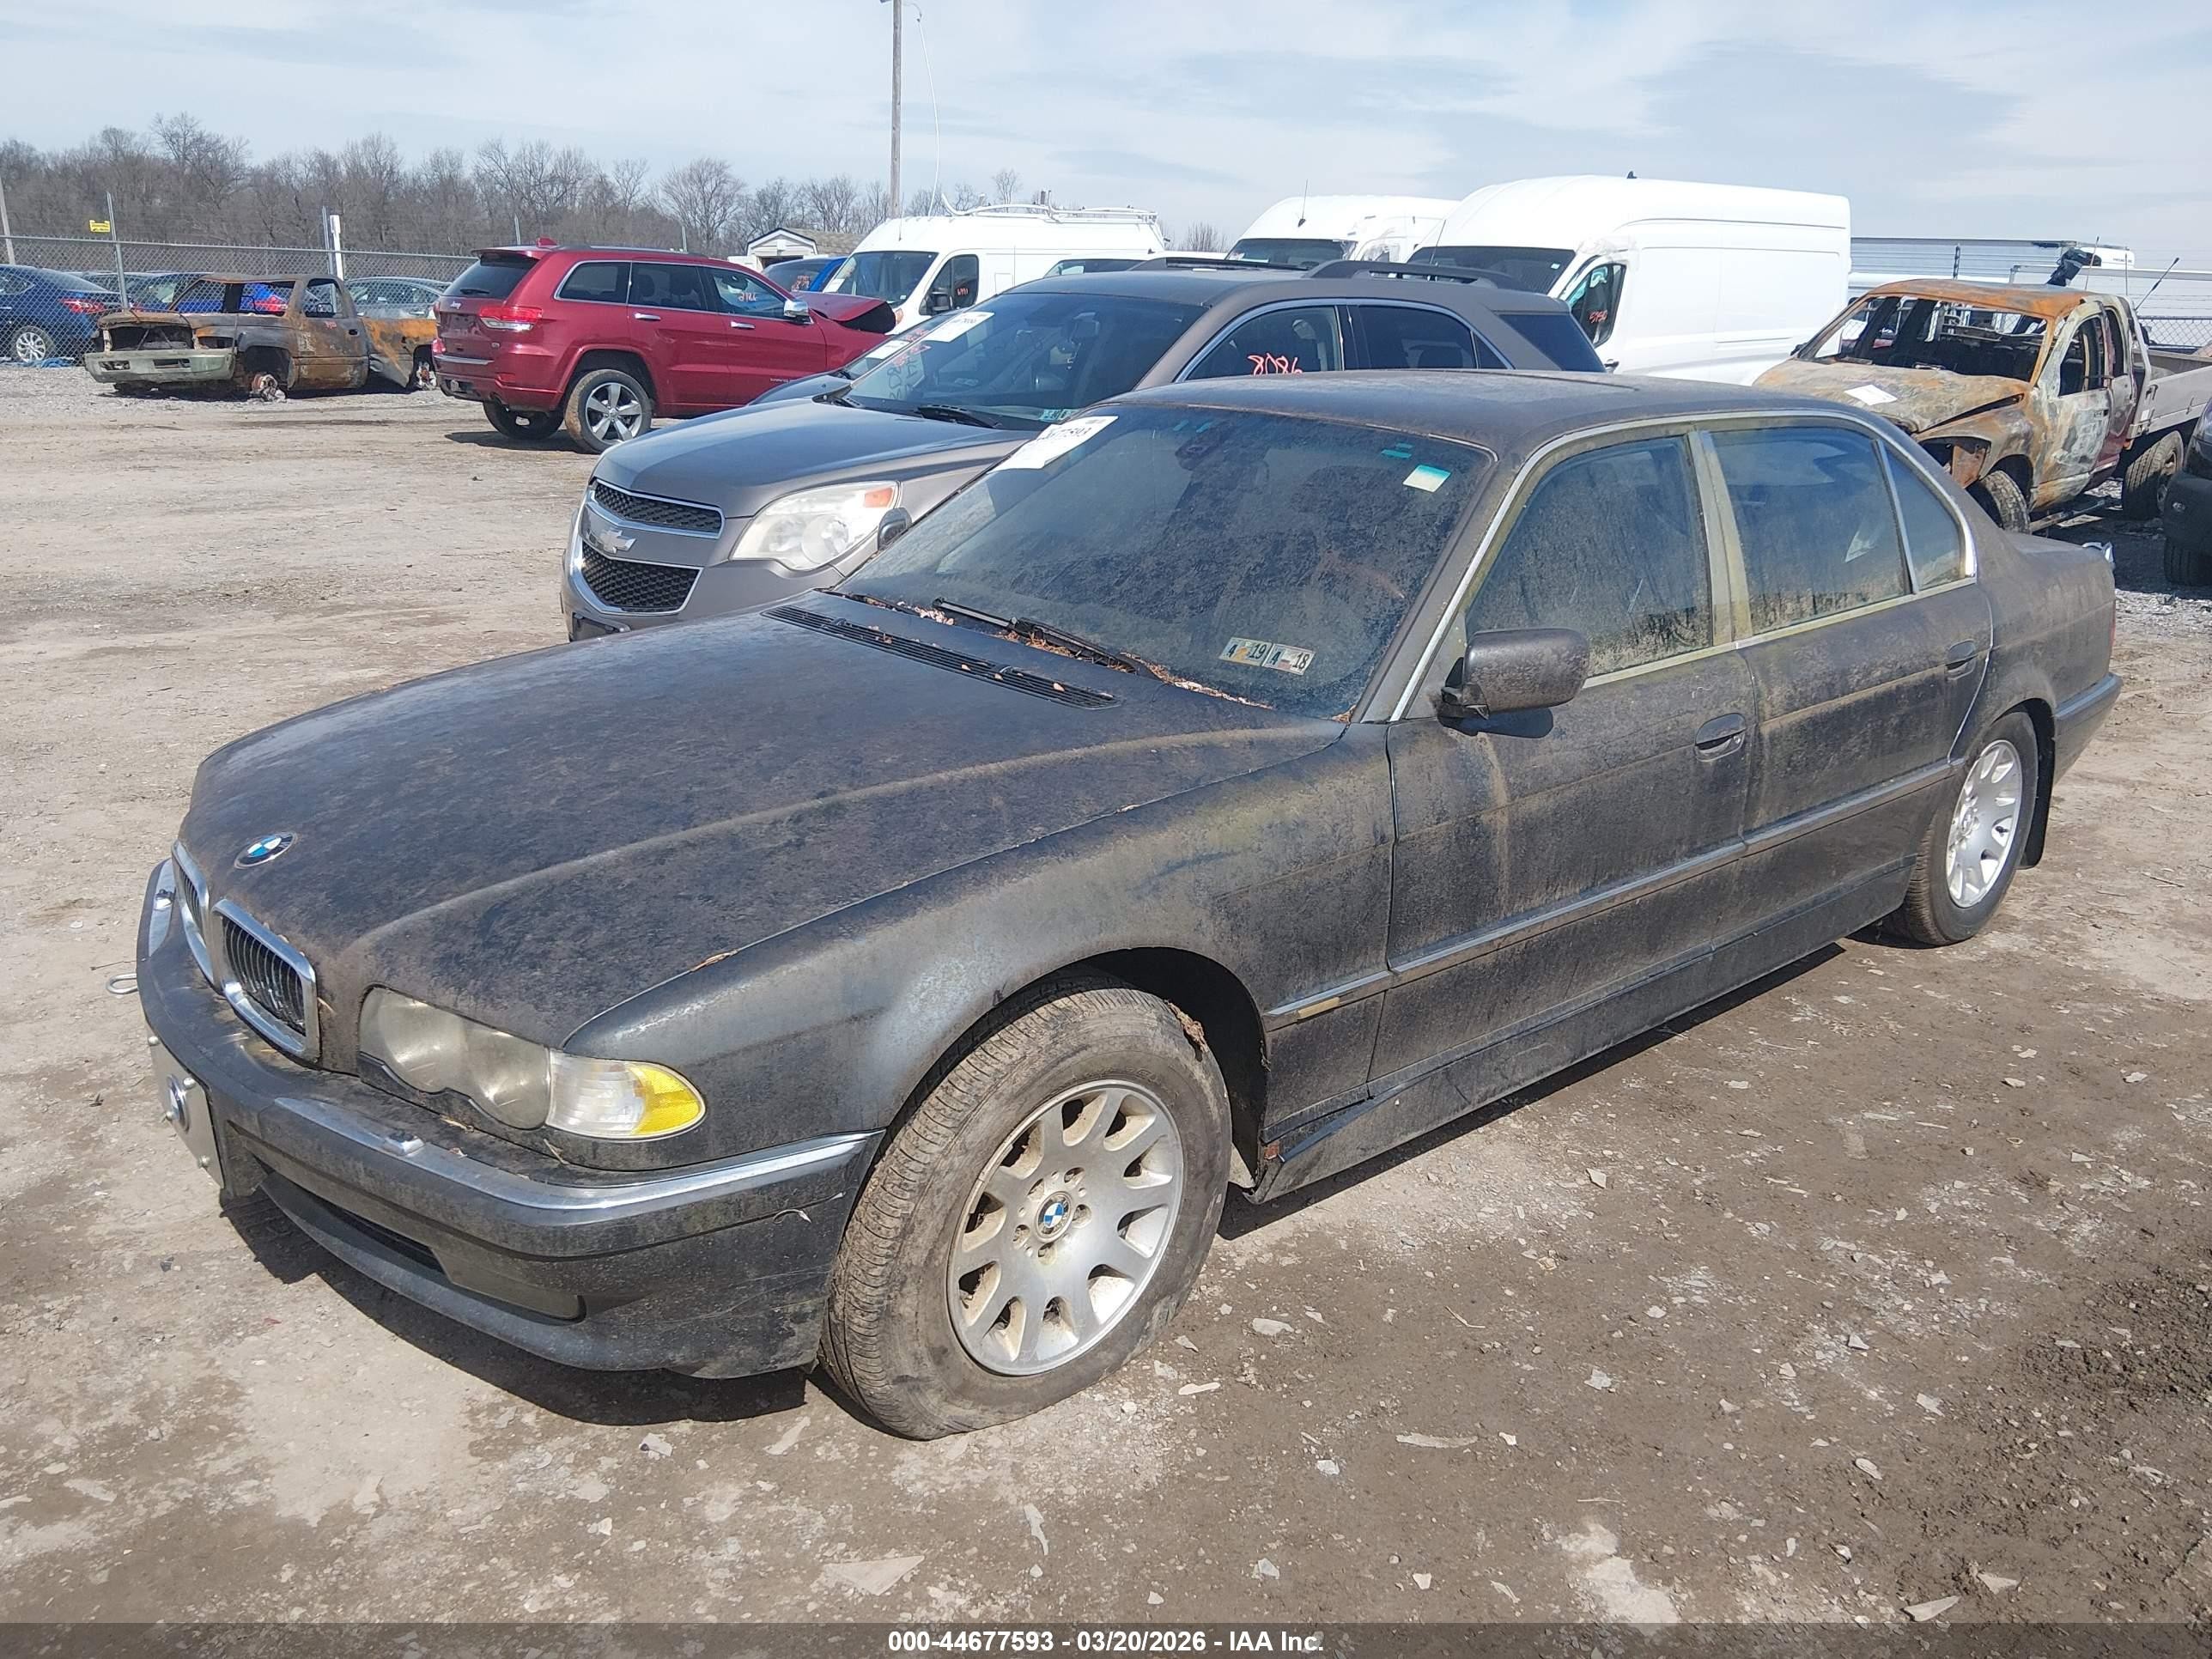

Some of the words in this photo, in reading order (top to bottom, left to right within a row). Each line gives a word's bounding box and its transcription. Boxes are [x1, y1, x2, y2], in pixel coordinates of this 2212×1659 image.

[1249, 643, 1267, 659] 19
[1270, 651, 1281, 665] 4
[1292, 652, 1310, 670] 18
